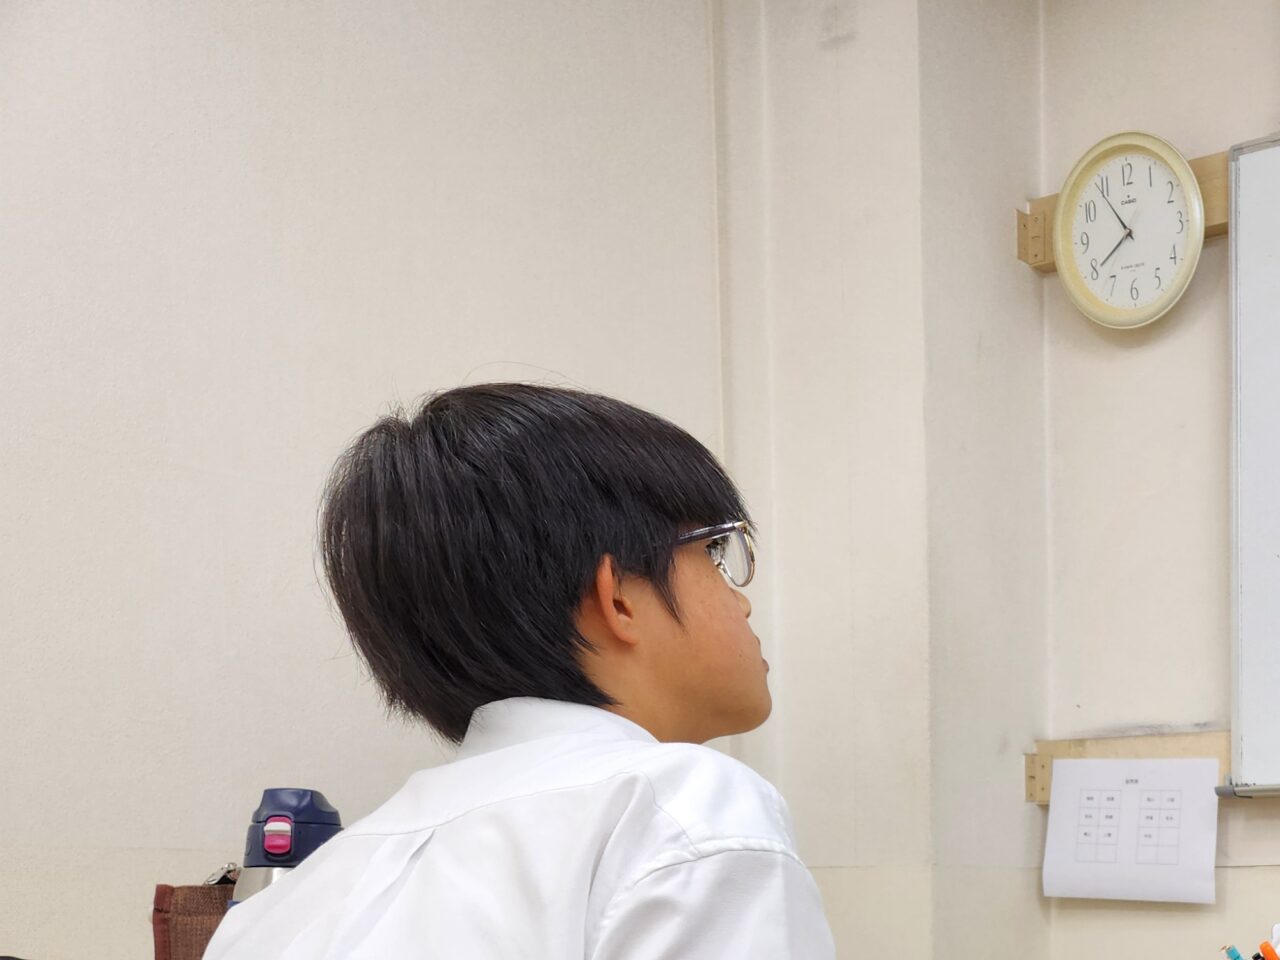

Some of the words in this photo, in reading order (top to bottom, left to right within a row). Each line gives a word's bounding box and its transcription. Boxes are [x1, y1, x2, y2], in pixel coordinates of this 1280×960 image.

[1122, 162, 1133, 186] 12
[1100, 175, 1109, 198] 11
[1167, 181, 1175, 204] 2
[1084, 200, 1097, 223] 10
[1176, 210, 1184, 234] 3
[1080, 231, 1090, 255] 9
[1169, 243, 1177, 265] 4
[1090, 258, 1099, 281] 8
[1154, 267, 1161, 290] 5
[1110, 275, 1117, 297] 7
[1130, 277, 1139, 300] 6
